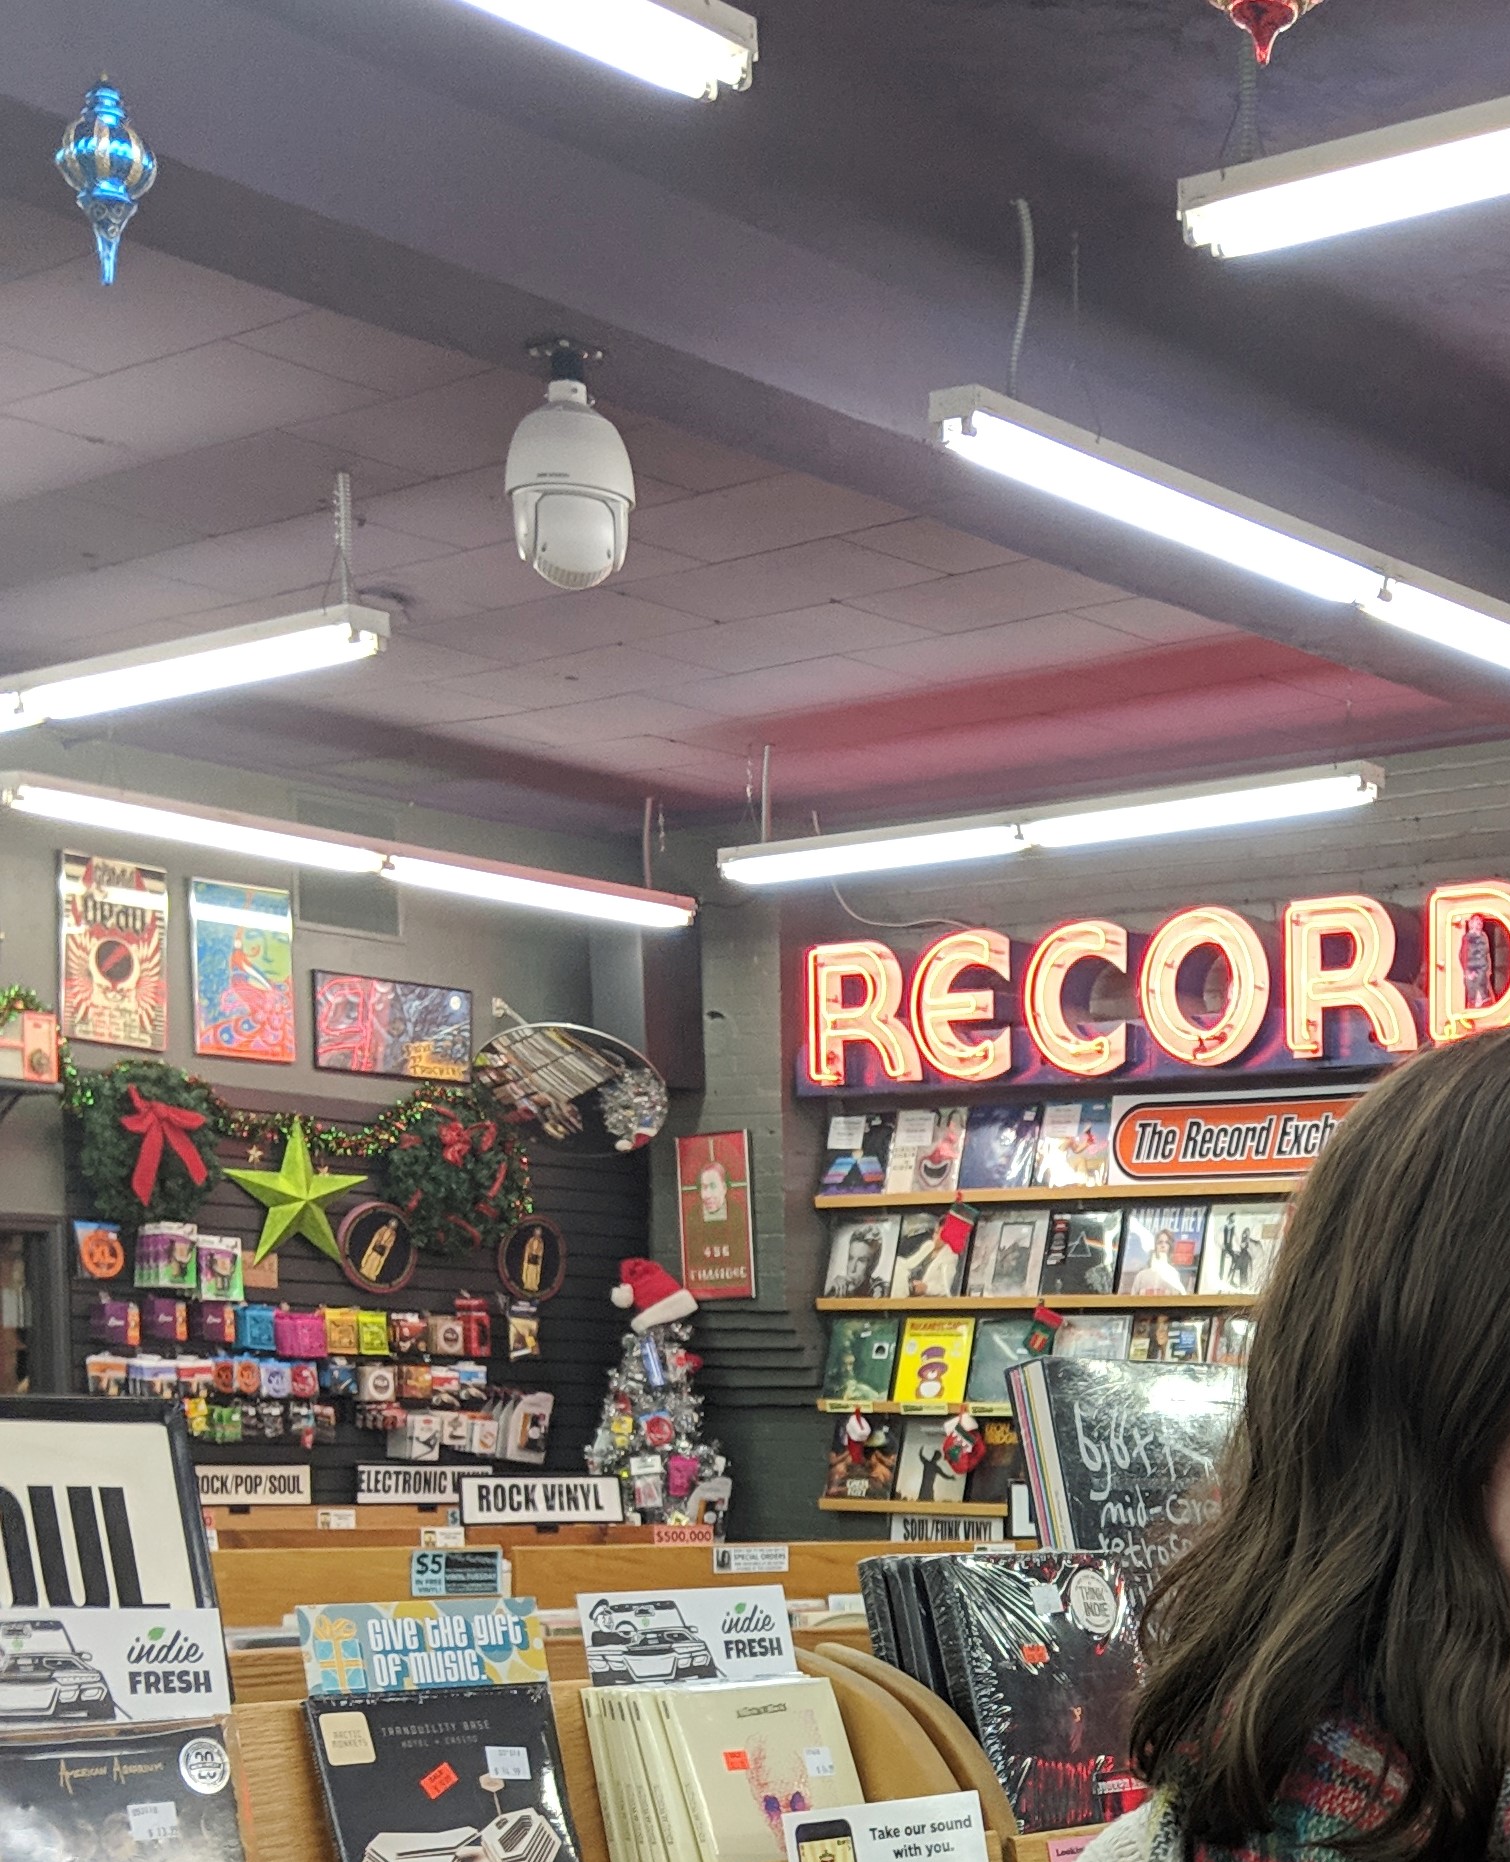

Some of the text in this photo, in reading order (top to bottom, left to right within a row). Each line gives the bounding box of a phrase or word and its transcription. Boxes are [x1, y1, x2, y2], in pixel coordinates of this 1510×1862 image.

[1133, 1121, 1177, 1162] The
[1181, 1115, 1274, 1161] Record
[197, 1470, 304, 1496] OCK/POP/SOUL
[358, 1470, 449, 1496] ELECTRONIC
[477, 1480, 605, 1513] ROCK VINYL
[655, 1529, 713, 1544] $500,000
[902, 1517, 993, 1541] SOUL/FUNK VINYL
[416, 1552, 443, 1574] $5
[1079, 1584, 1106, 1602] THINK
[721, 1607, 776, 1635] indie
[1083, 1600, 1111, 1618] INDIE
[126, 1628, 205, 1664] indie
[723, 1636, 784, 1661] FRESH
[128, 1669, 213, 1695] FRESH
[373, 1652, 404, 1688] OF
[462, 1719, 491, 1732] BASE
[869, 1814, 974, 1842] Take our sound
[893, 1840, 956, 1861] with you.
